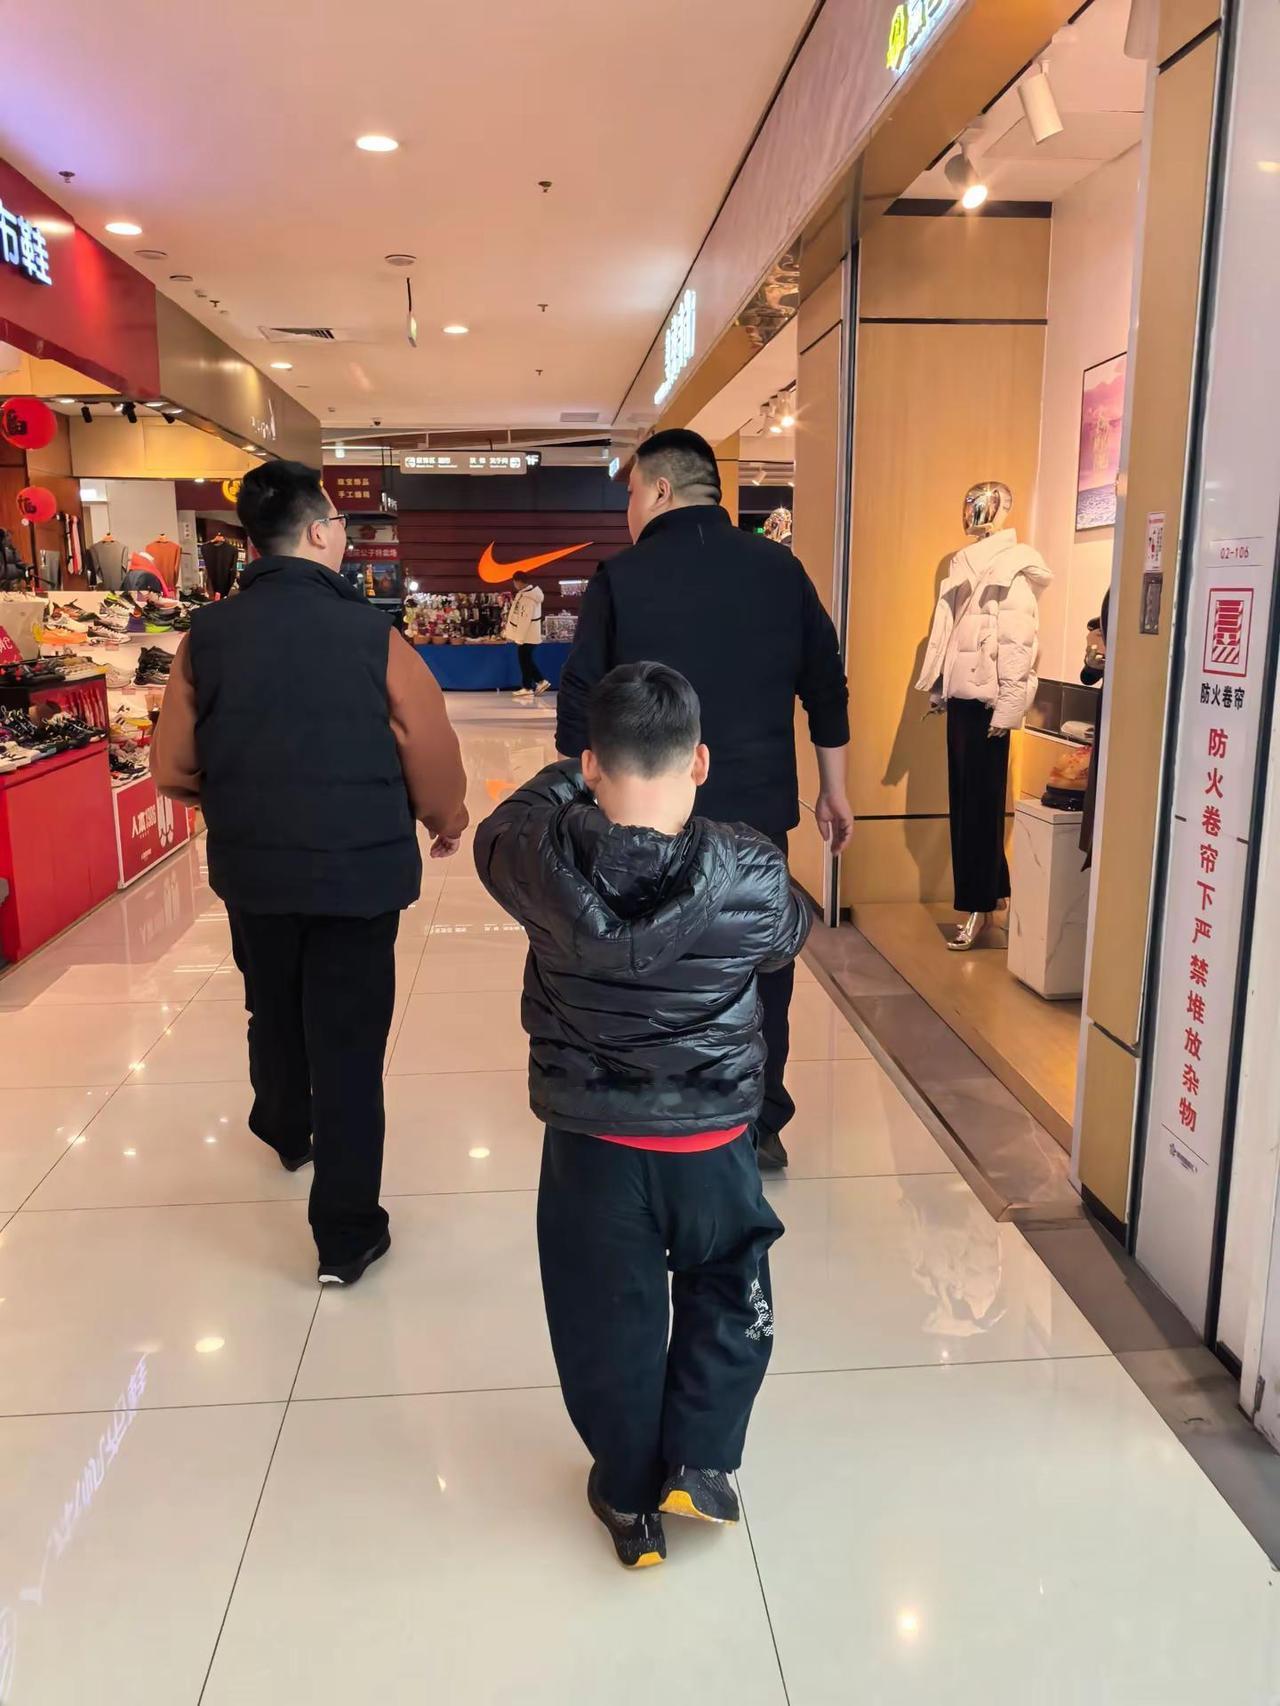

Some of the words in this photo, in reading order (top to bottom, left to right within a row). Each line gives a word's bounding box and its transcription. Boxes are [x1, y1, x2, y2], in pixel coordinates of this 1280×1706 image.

[525, 454, 540, 466] 1F
[1220, 547, 1249, 559] 02-106
[1200, 682, 1245, 710] 防火卷帘
[1179, 728, 1228, 1132] 防火卷帘下严禁堆放杂物
